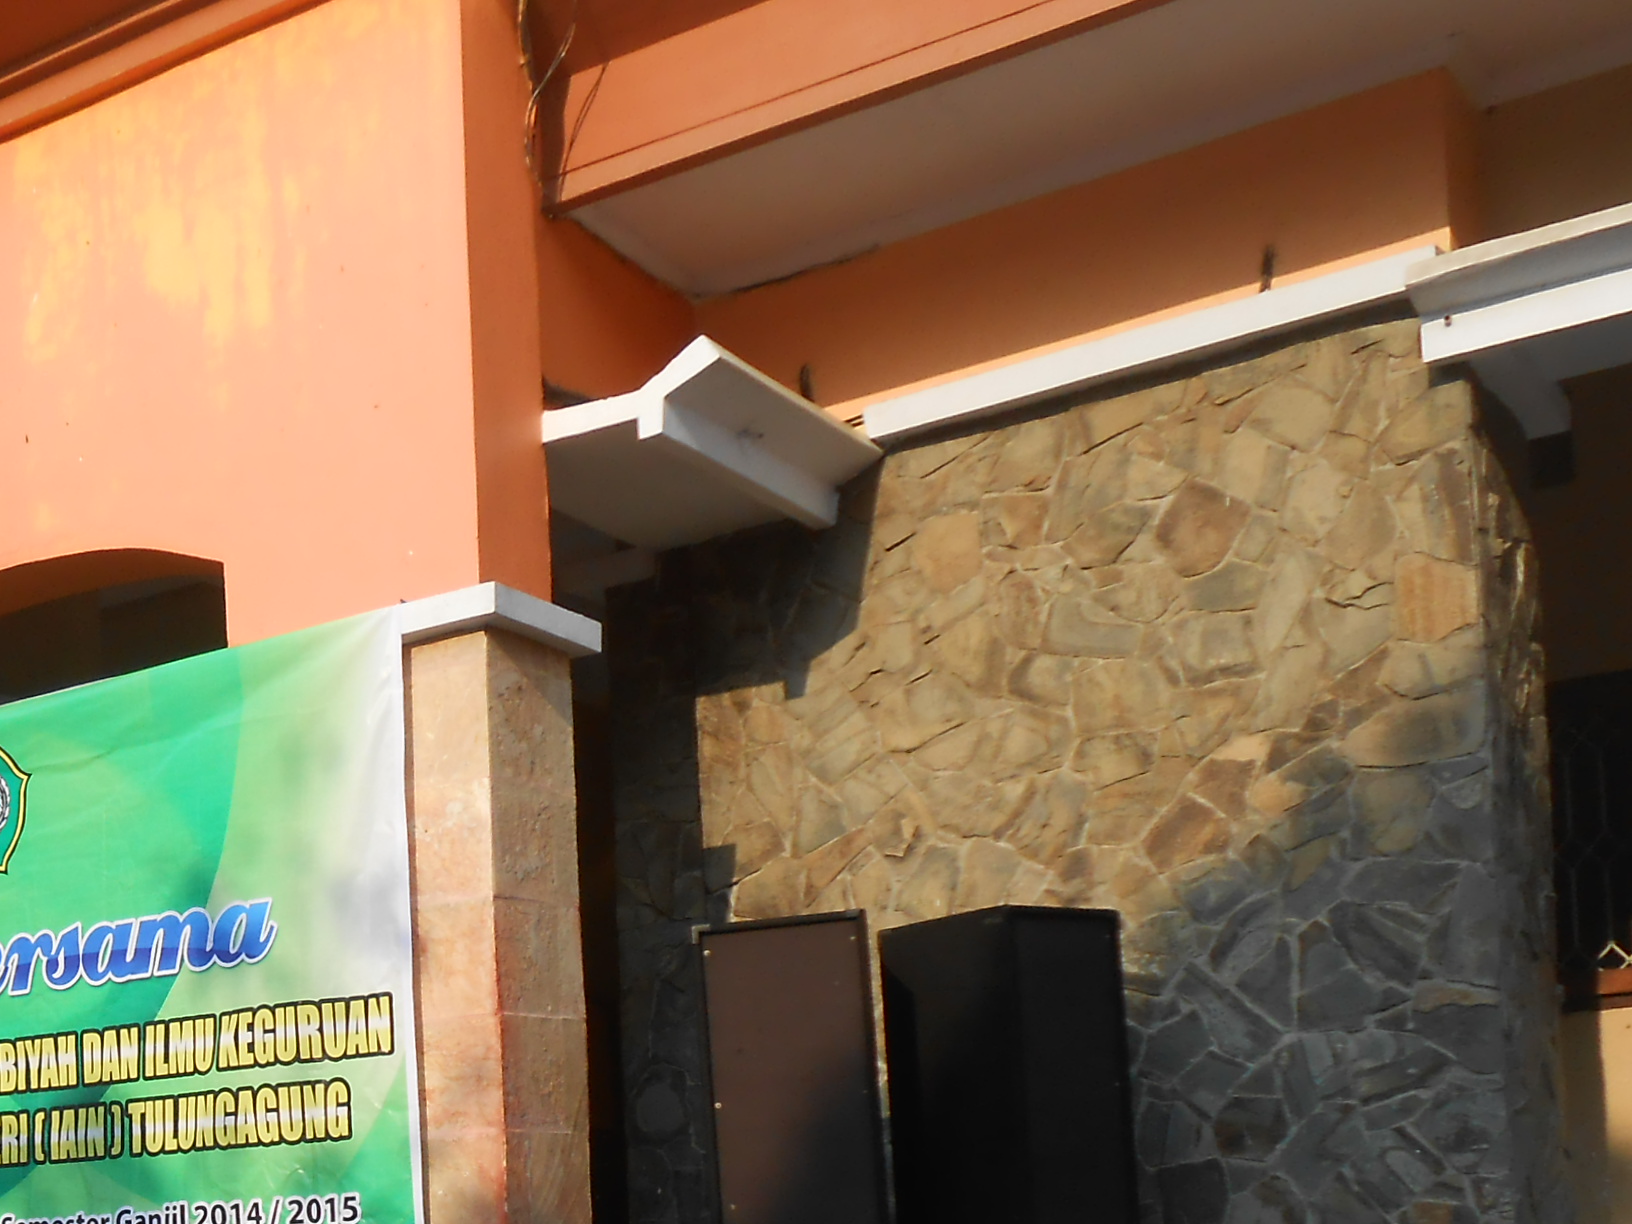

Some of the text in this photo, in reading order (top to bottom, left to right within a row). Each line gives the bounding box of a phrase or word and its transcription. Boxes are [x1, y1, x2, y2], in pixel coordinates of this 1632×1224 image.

[81, 1026, 139, 1085] DAN
[144, 1015, 217, 1077] ILMU
[218, 994, 392, 1069] KEGURUAN
[127, 1080, 351, 1155] TULUNGAGUNG
